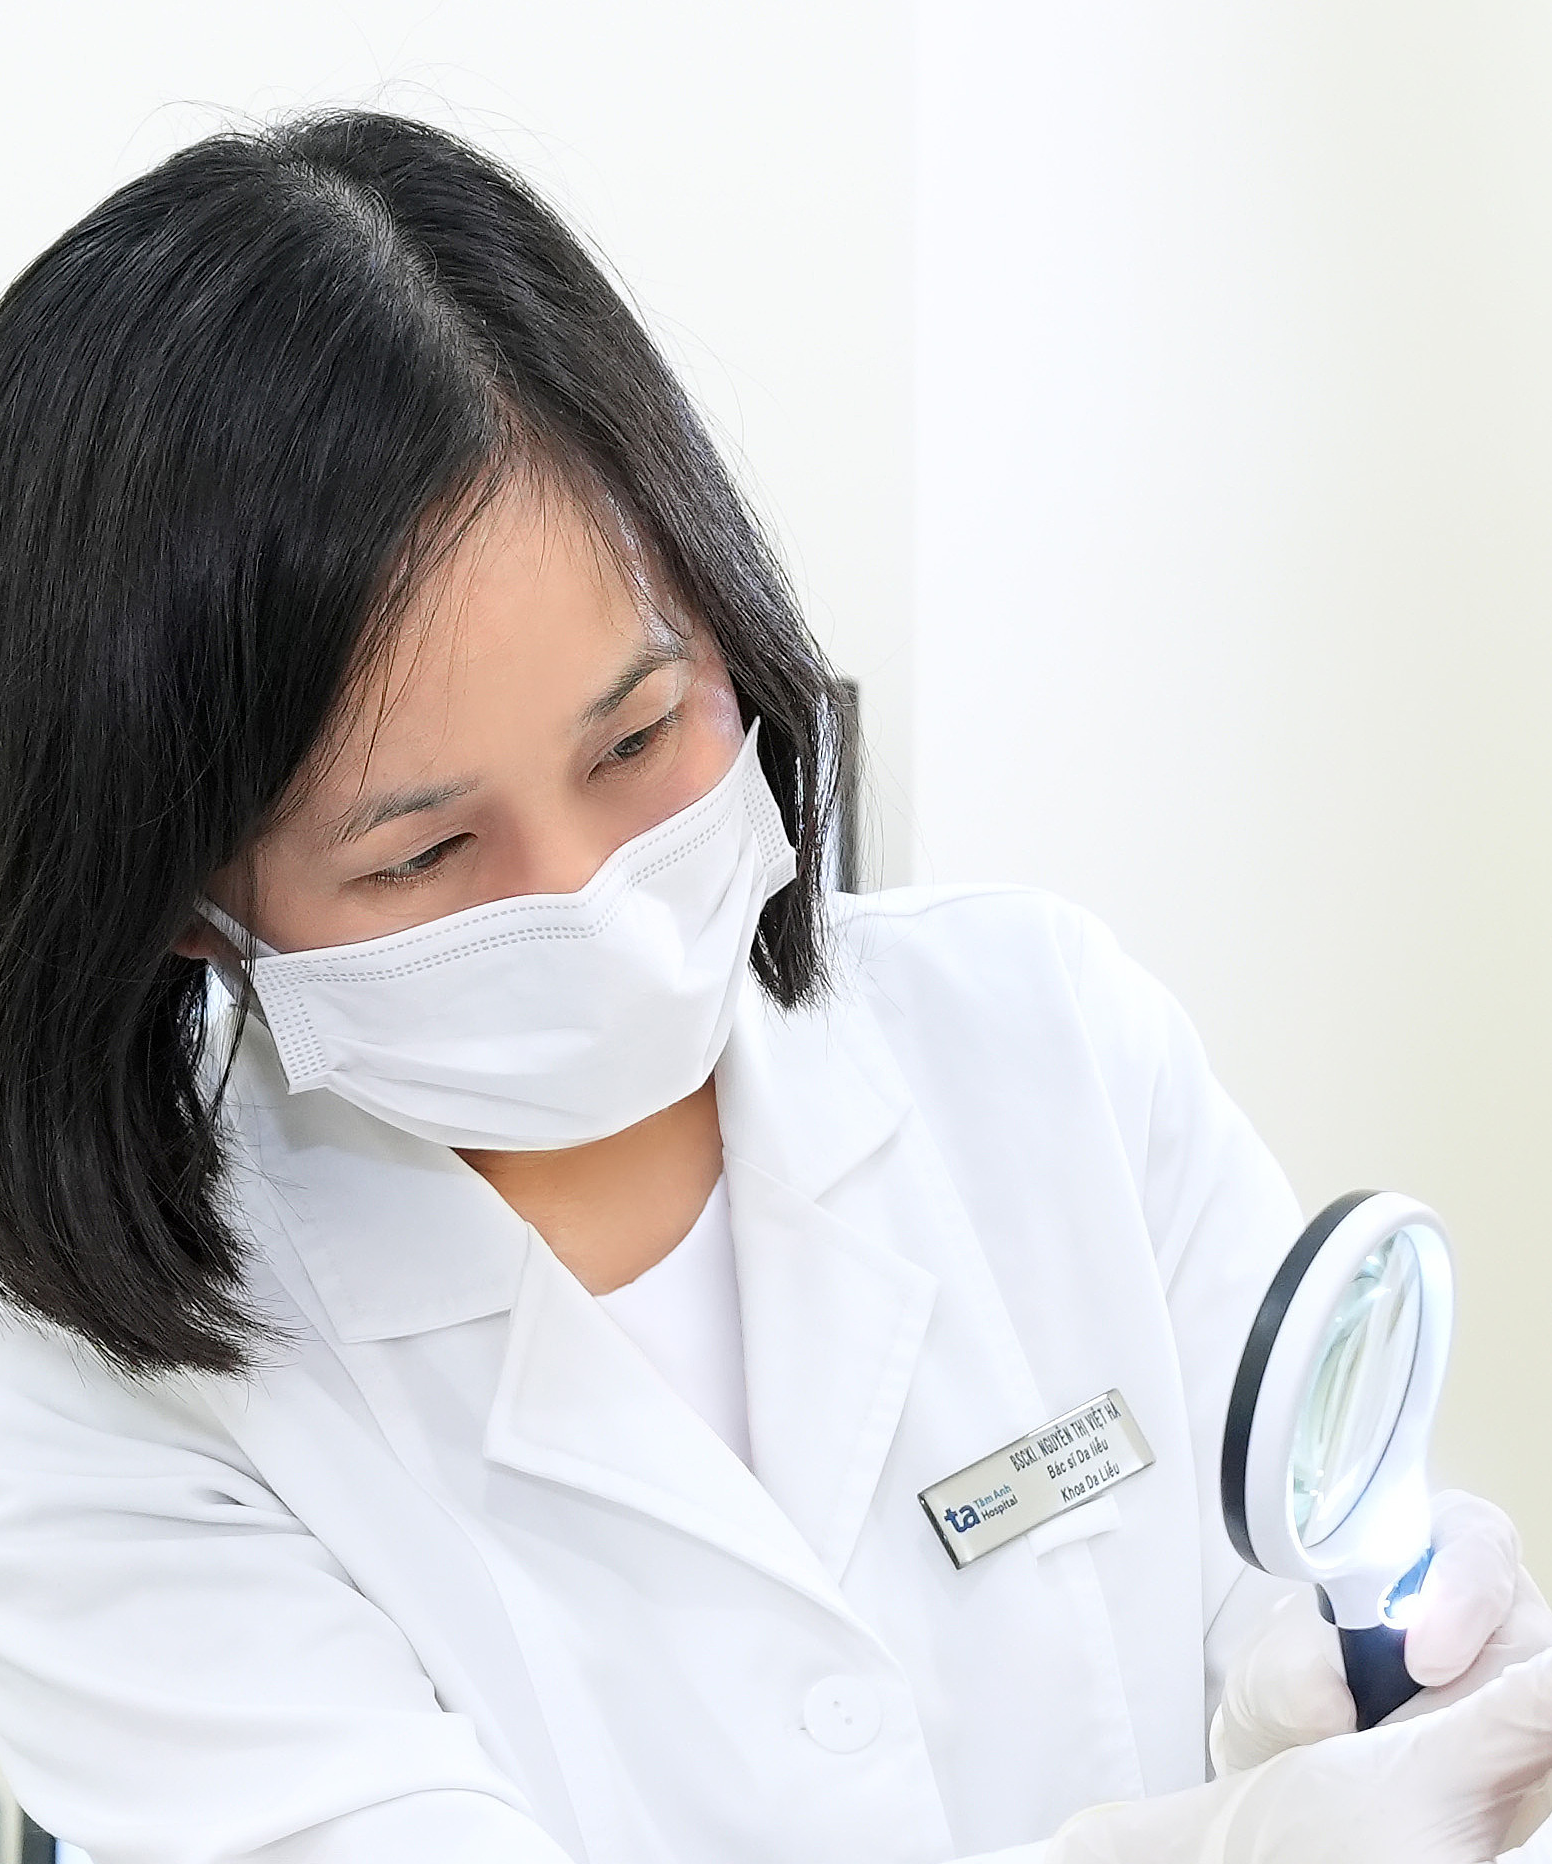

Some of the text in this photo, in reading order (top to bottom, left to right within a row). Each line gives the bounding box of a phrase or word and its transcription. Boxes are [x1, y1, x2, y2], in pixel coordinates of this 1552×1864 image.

[1046, 1460, 1067, 1480] Bác
[1076, 1449, 1091, 1464] Da
[993, 1484, 1012, 1499] Anh
[1060, 1482, 1086, 1503] Khoa
[1085, 1475, 1100, 1490] Da
[944, 1505, 981, 1533] ta
[981, 1494, 1019, 1521] Hospital
